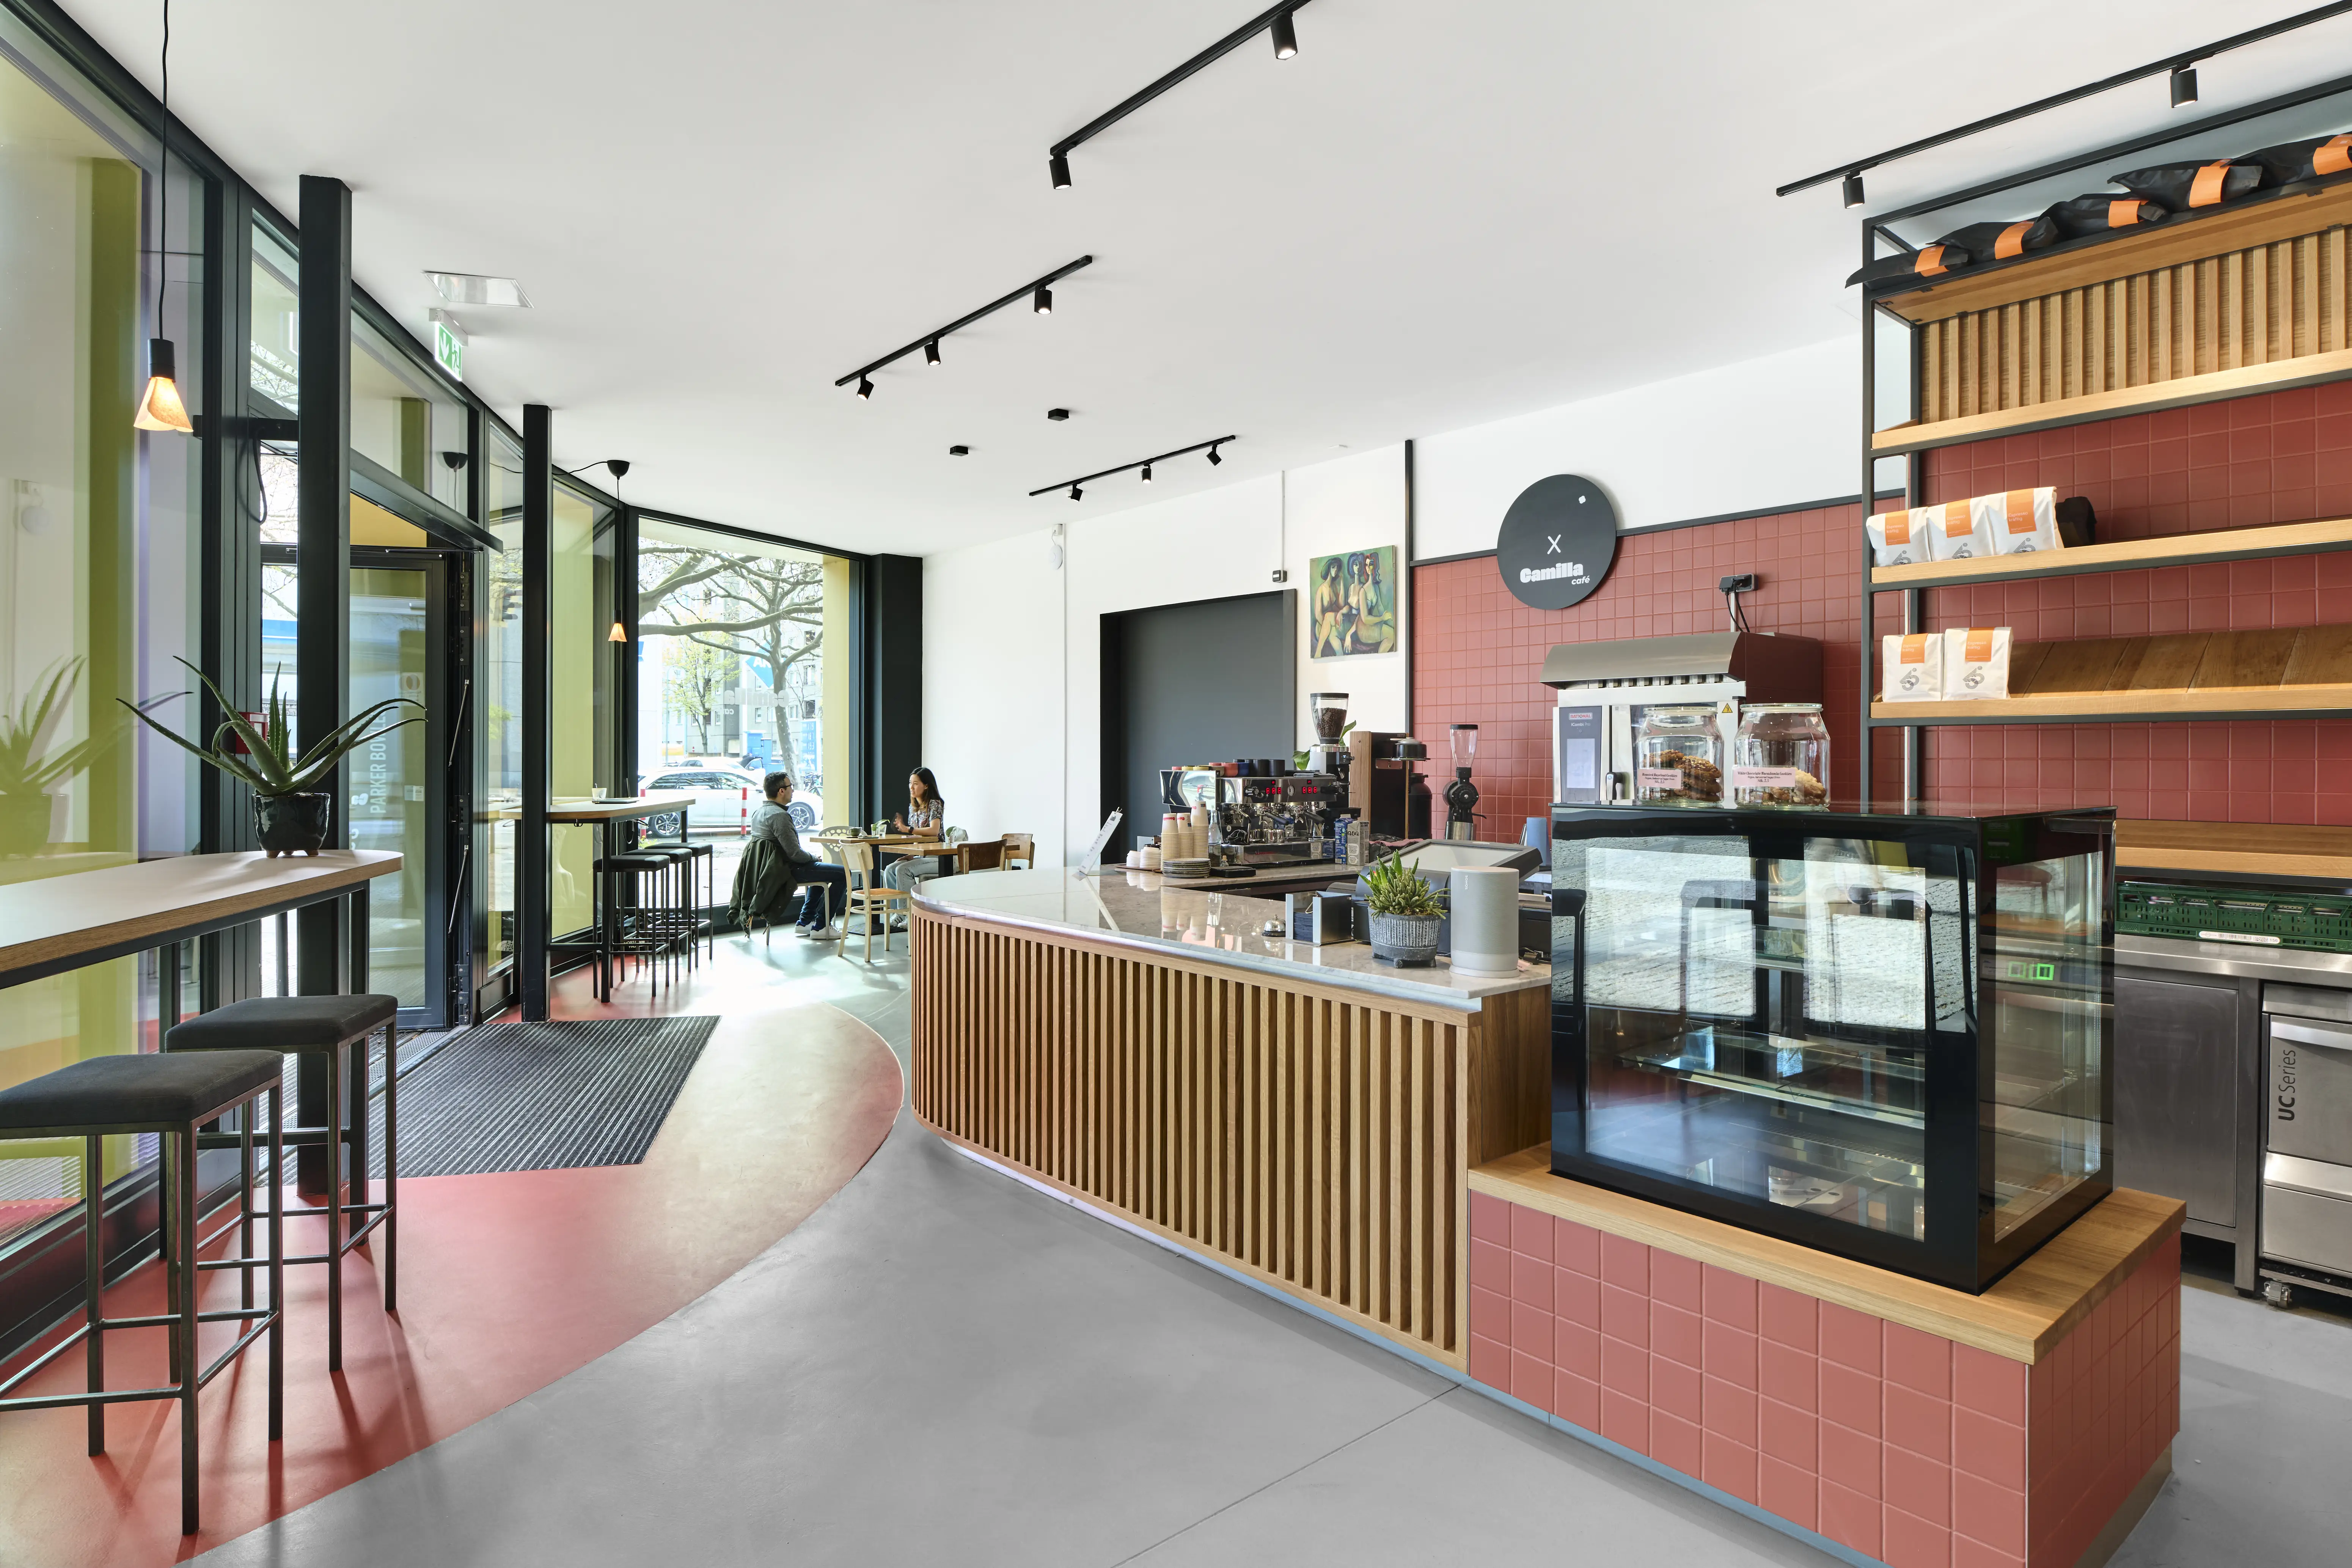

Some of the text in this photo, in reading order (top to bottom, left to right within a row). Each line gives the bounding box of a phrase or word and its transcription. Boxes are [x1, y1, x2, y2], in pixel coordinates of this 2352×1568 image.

[1520, 562, 1584, 583] Camilla
[1571, 575, 1590, 585] café
[370, 764, 387, 813] PARKER
[2278, 1050, 2296, 1121] UC Series
